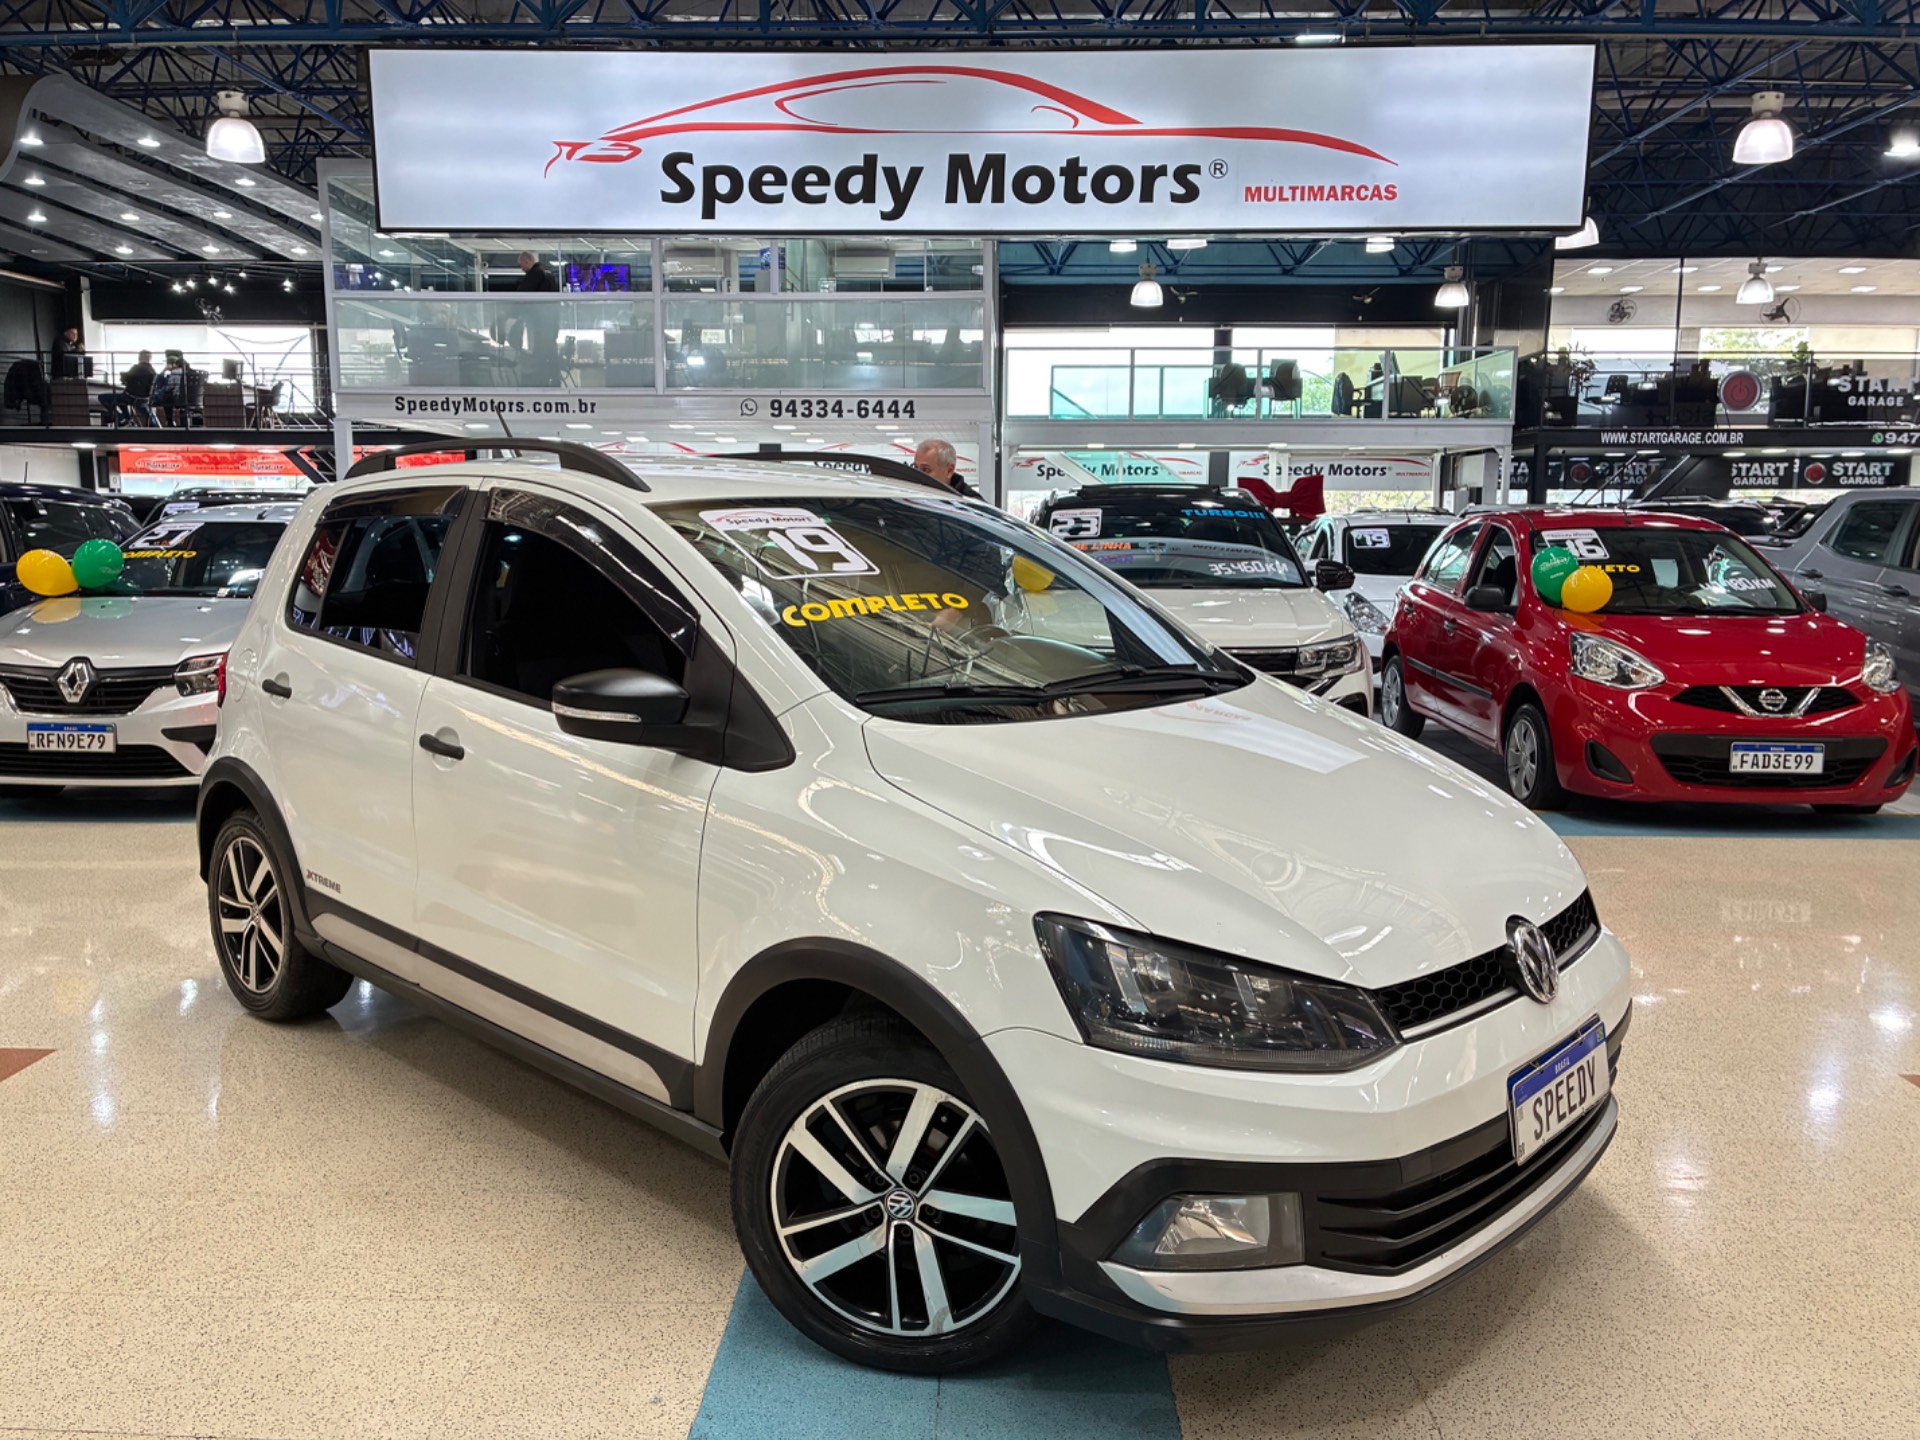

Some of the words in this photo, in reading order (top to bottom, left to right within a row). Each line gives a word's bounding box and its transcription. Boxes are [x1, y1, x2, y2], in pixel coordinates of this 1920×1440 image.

[660, 151, 924, 221] Speedy
[945, 153, 1202, 204] Motors
[1244, 184, 1398, 203] MULTIMARCAS
[395, 396, 597, 416] SpeedyMotors.com.br
[769, 398, 916, 419] 94334-6444
[1848, 396, 1904, 407] GARAGE
[1600, 431, 1745, 445] WWW.STARTGARAGE.COM.BR
[1327, 464, 1388, 477] Motors
[1832, 462, 1894, 476] START
[1733, 477, 1779, 485] GARAGE
[1839, 477, 1885, 485] GARAGE
[1052, 517, 1099, 537] 23
[767, 528, 868, 572] 19
[1091, 542, 1132, 551] LINHA
[1564, 538, 1606, 558] 16
[781, 592, 969, 627] COMPLETO
[36, 732, 106, 750] RFN9E79
[1739, 753, 1814, 770] FAD3E99
[306, 869, 342, 894] XTREME
[1532, 1055, 1596, 1142] SPEEDY
